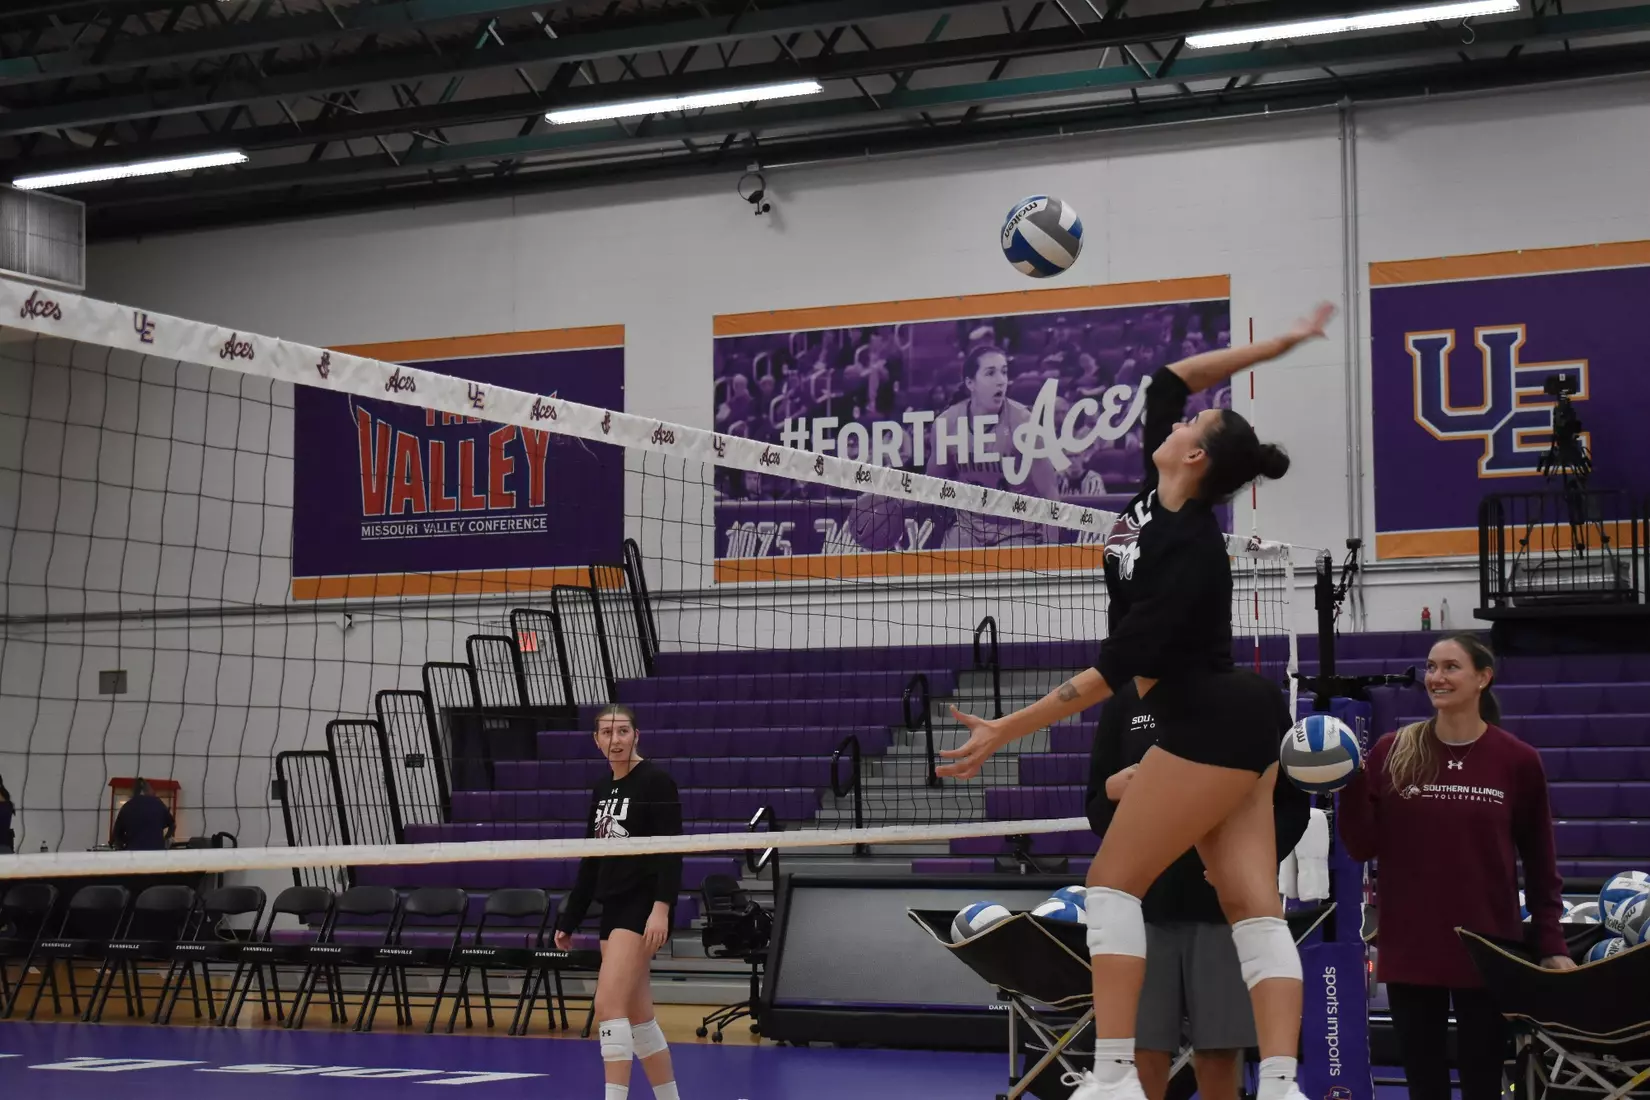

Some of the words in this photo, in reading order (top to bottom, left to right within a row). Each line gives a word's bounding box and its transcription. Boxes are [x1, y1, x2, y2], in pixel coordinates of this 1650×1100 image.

[1004, 202, 1038, 239] molten
[20, 290, 62, 321] Aces
[133, 311, 156, 344] UE
[220, 332, 255, 360] Aces
[385, 367, 417, 393] Aces
[468, 382, 485, 409] UE
[530, 397, 557, 421] Aces
[652, 423, 675, 445] Aces
[1404, 323, 1591, 478] UE
[357, 390, 557, 517] VALLEY
[361, 523, 418, 537] MISSOURI
[423, 520, 465, 534] VALLEY
[468, 517, 548, 532] CONFERENCE
[1423, 784, 1470, 793] SOUTHERN
[1471, 786, 1504, 798] ILLINOIS
[1434, 793, 1492, 803] VOLLEYBALL
[1322, 966, 1339, 1014] sports
[1325, 1016, 1342, 1077] imports
